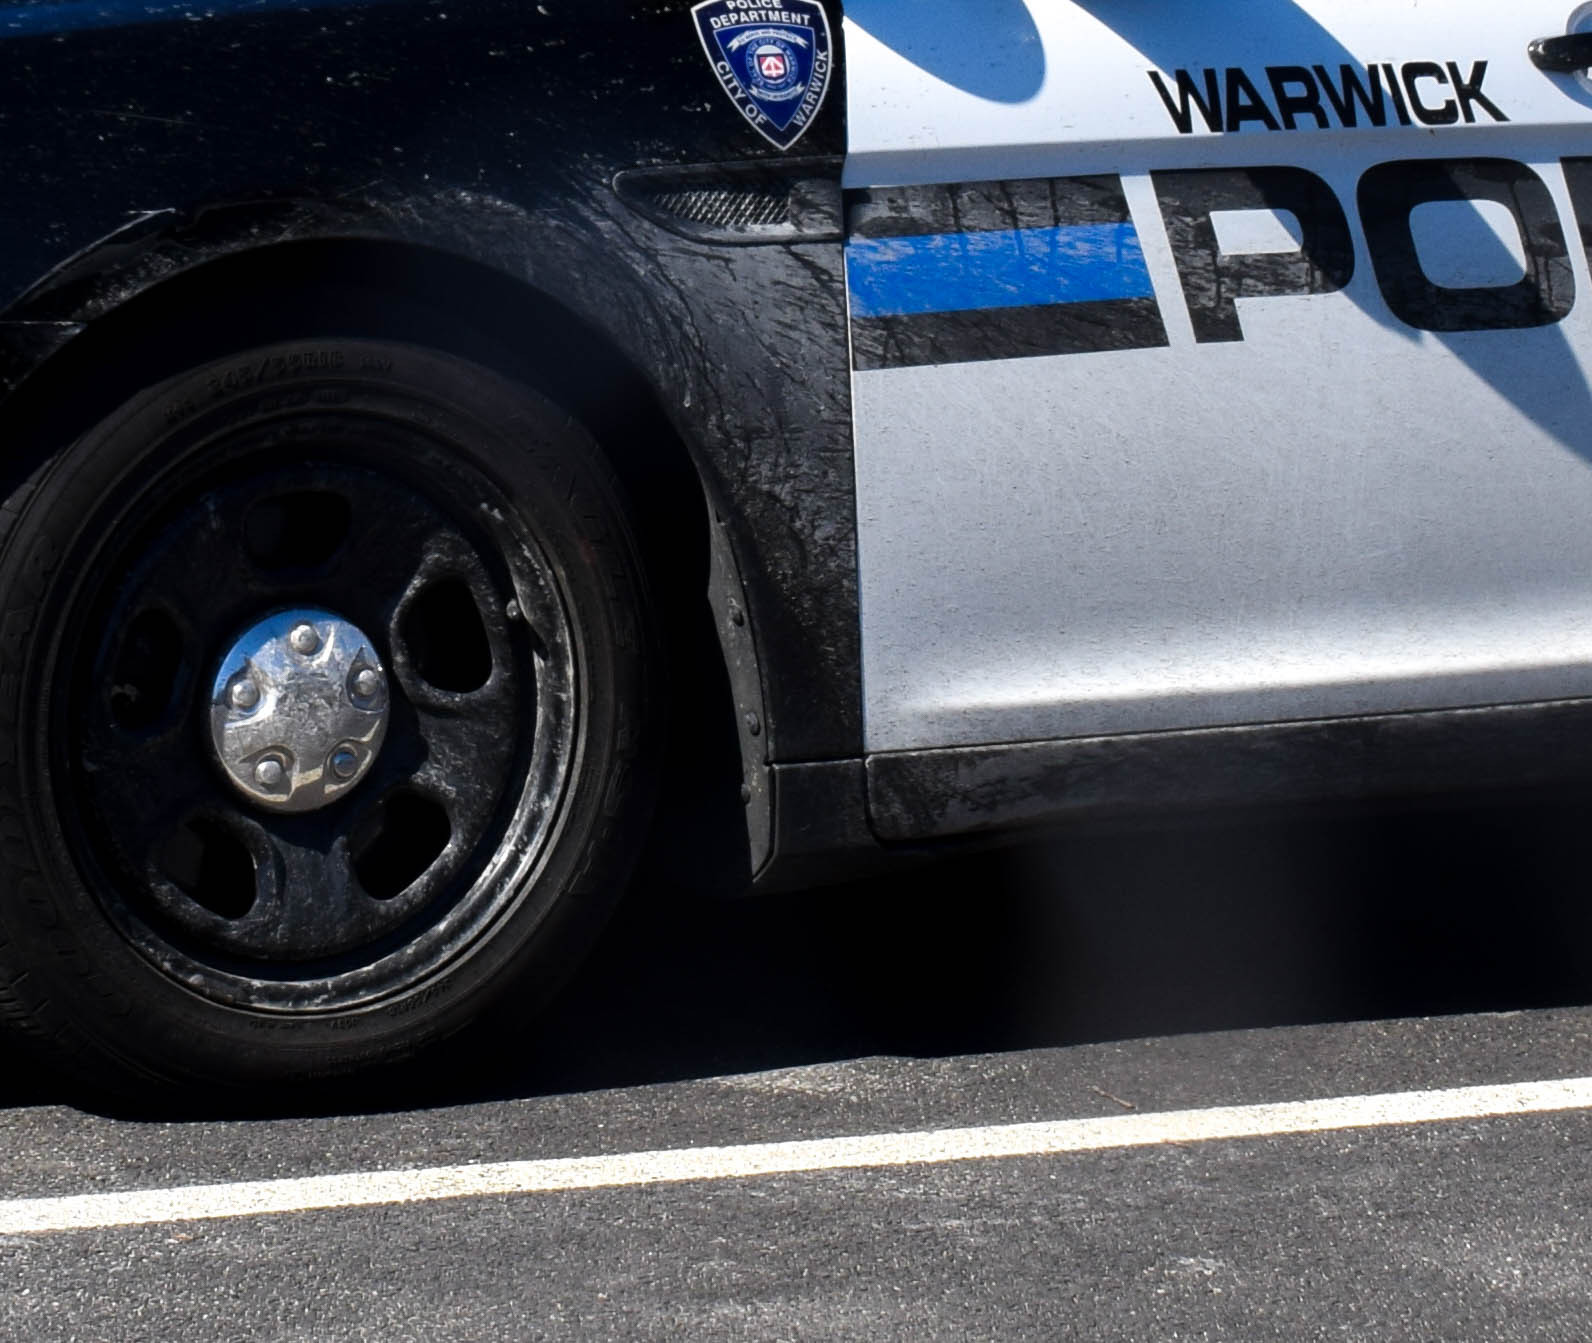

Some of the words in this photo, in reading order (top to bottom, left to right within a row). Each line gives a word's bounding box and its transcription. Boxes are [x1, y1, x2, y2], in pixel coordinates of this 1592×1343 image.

[710, 10, 811, 29] DEPARTMENT
[717, 60, 746, 101] CITY
[744, 103, 768, 126] OF
[793, 48, 829, 128] WARWICK
[1148, 60, 1509, 134] WARWICK
